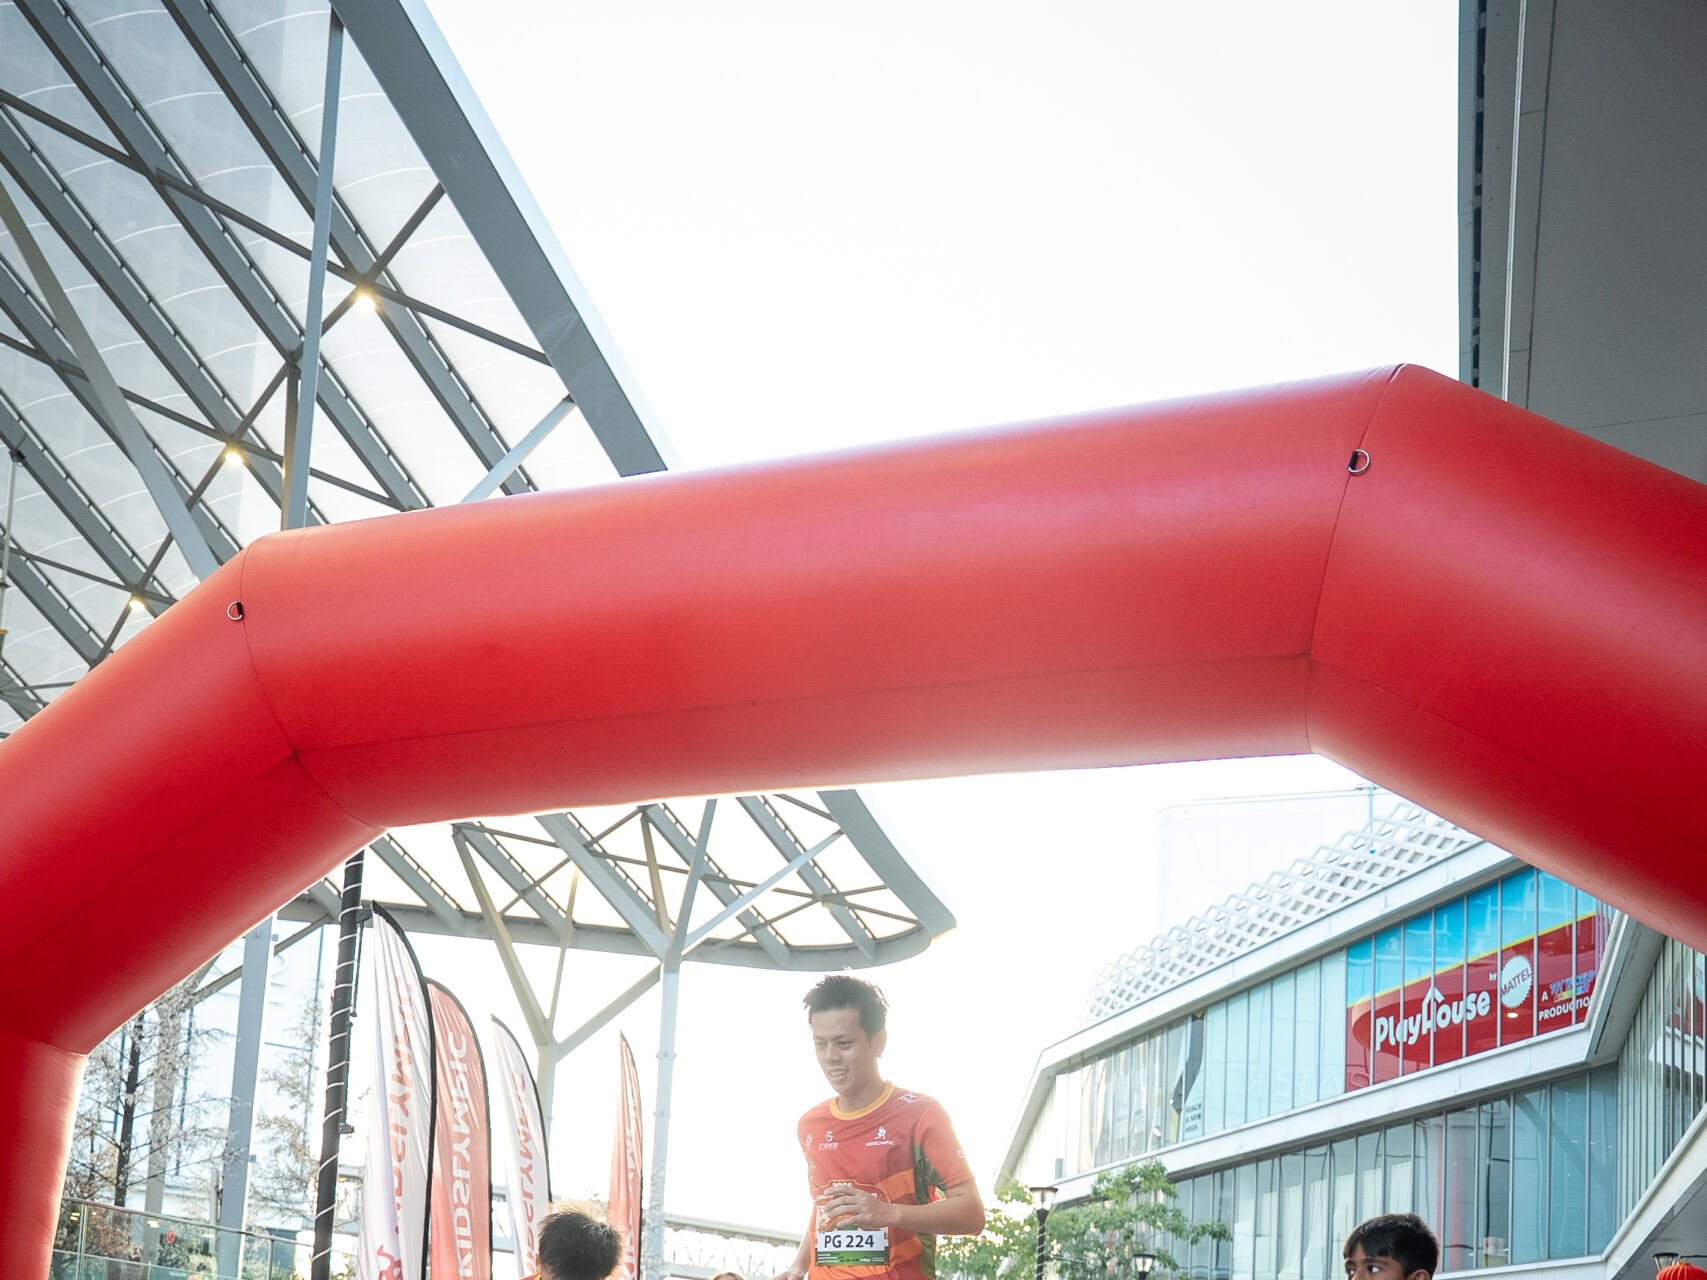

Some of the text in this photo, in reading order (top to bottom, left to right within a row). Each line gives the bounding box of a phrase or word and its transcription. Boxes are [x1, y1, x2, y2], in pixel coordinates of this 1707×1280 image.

[1500, 968, 1533, 997] MATTEL
[1541, 990, 1548, 1002] A
[1538, 996, 1593, 1021] PRODUCTIO
[824, 1235, 875, 1248] PG 224
